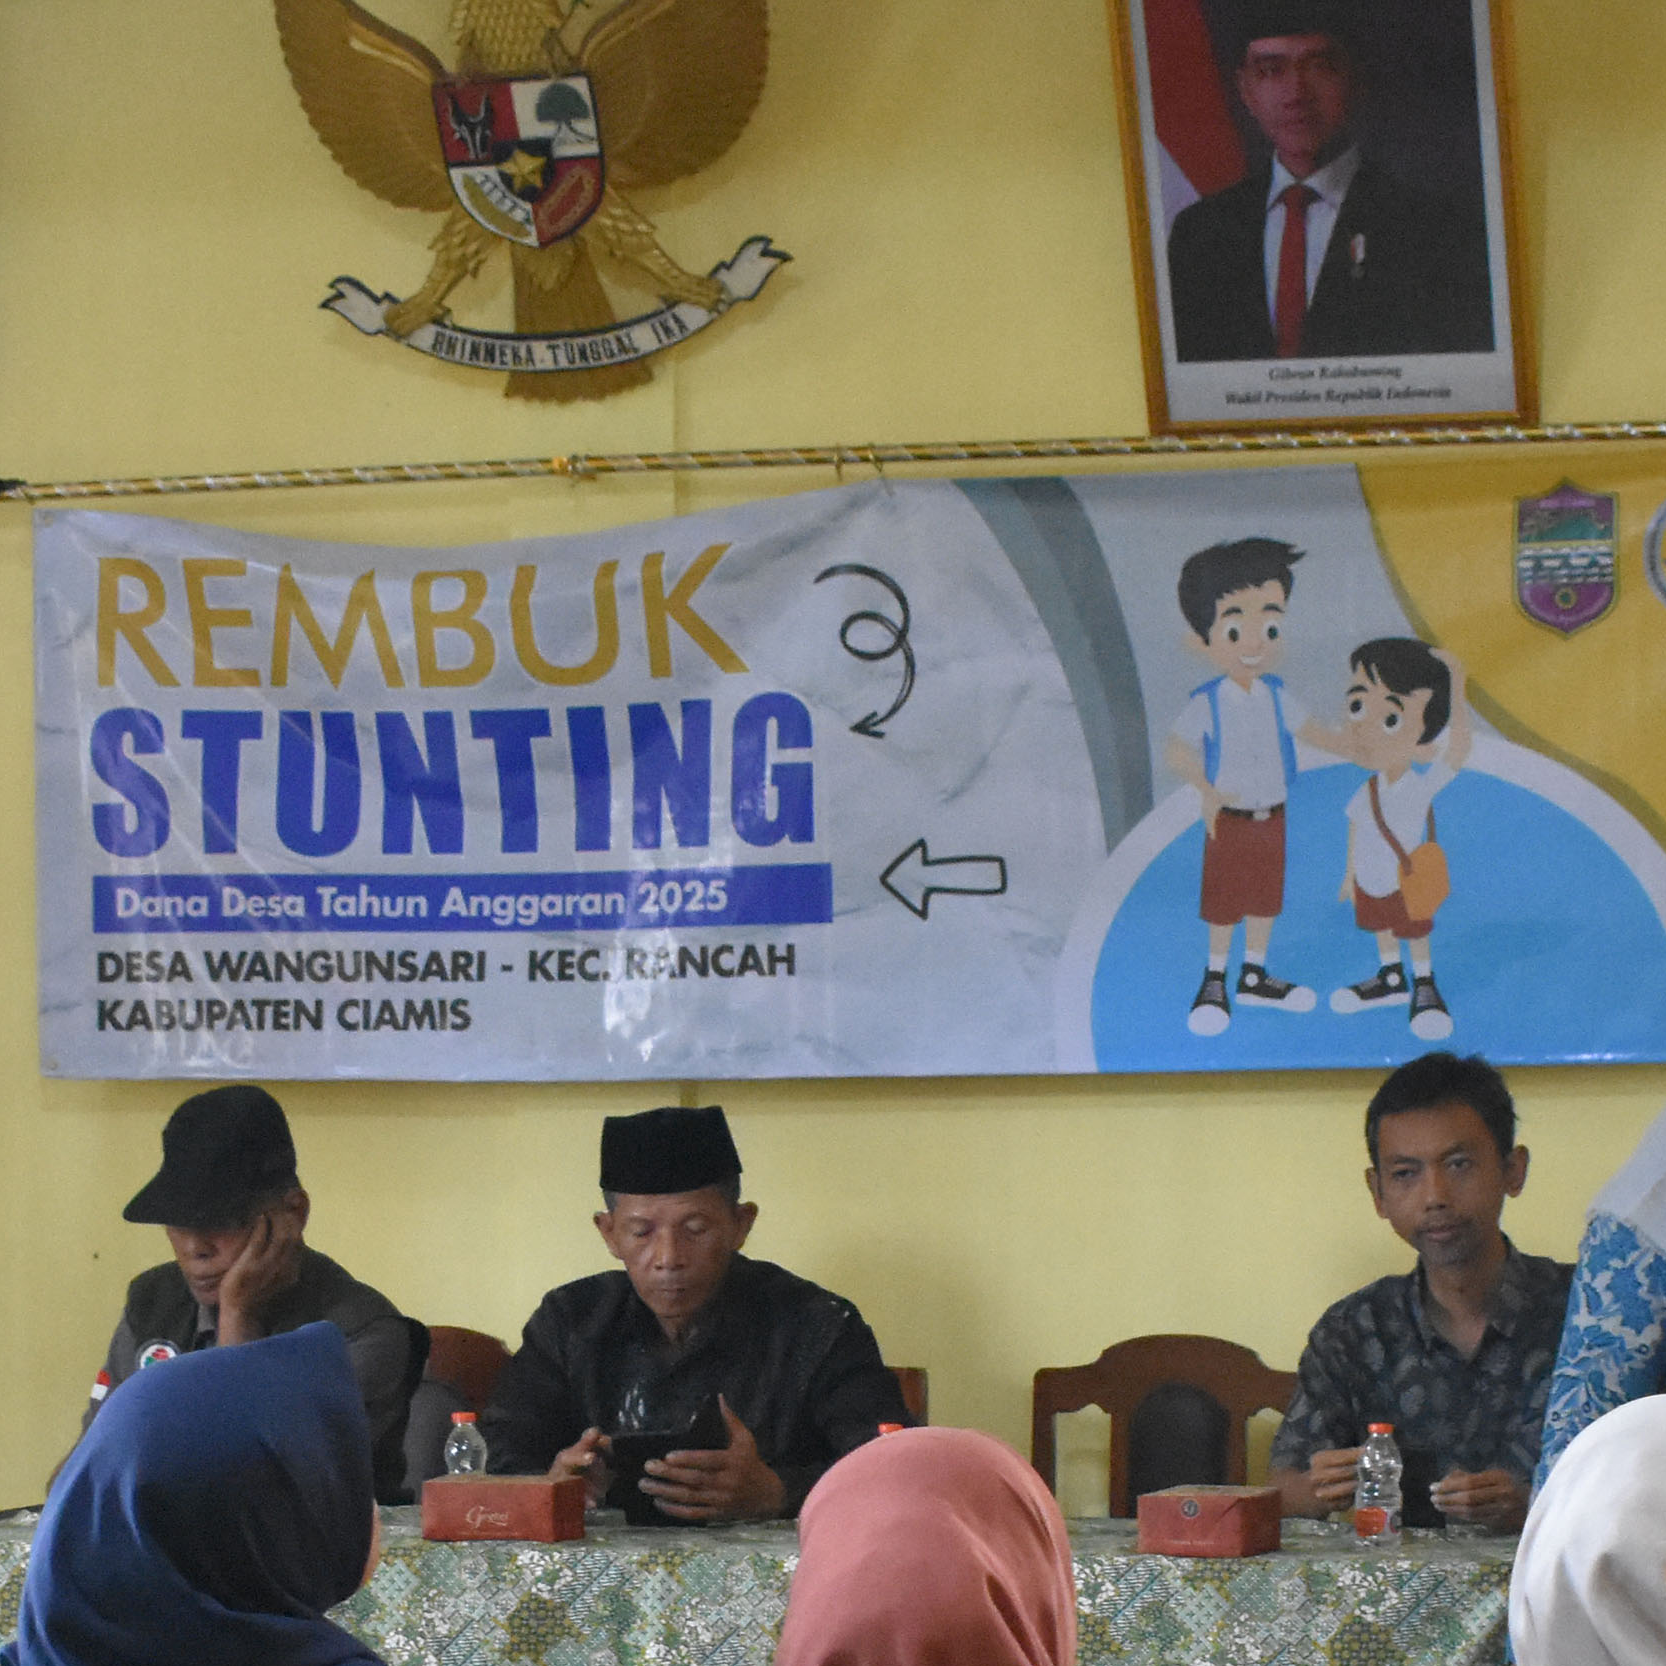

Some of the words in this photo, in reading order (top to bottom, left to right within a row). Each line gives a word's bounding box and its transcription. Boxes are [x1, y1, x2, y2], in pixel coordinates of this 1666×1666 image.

[433, 330, 536, 367] BHINNEKA
[546, 331, 638, 367] TUNGGAL
[650, 311, 690, 345] IKA
[1325, 388, 1382, 403] Republik
[1386, 386, 1452, 401] Indonesia
[96, 540, 750, 690] REMBUK
[90, 690, 815, 859] STUNTING
[116, 886, 209, 919] Dana
[221, 888, 305, 919] Desa
[316, 885, 428, 918] Tahun
[440, 885, 625, 925] Anggaran
[637, 880, 729, 914] 2025
[96, 950, 192, 983] DESA
[204, 949, 486, 983] WANGUNSARI
[527, 947, 611, 981] KEC.
[627, 944, 797, 980] RANCAH
[96, 999, 324, 1033] KABUPATEN
[337, 998, 472, 1032] CIAMIS
